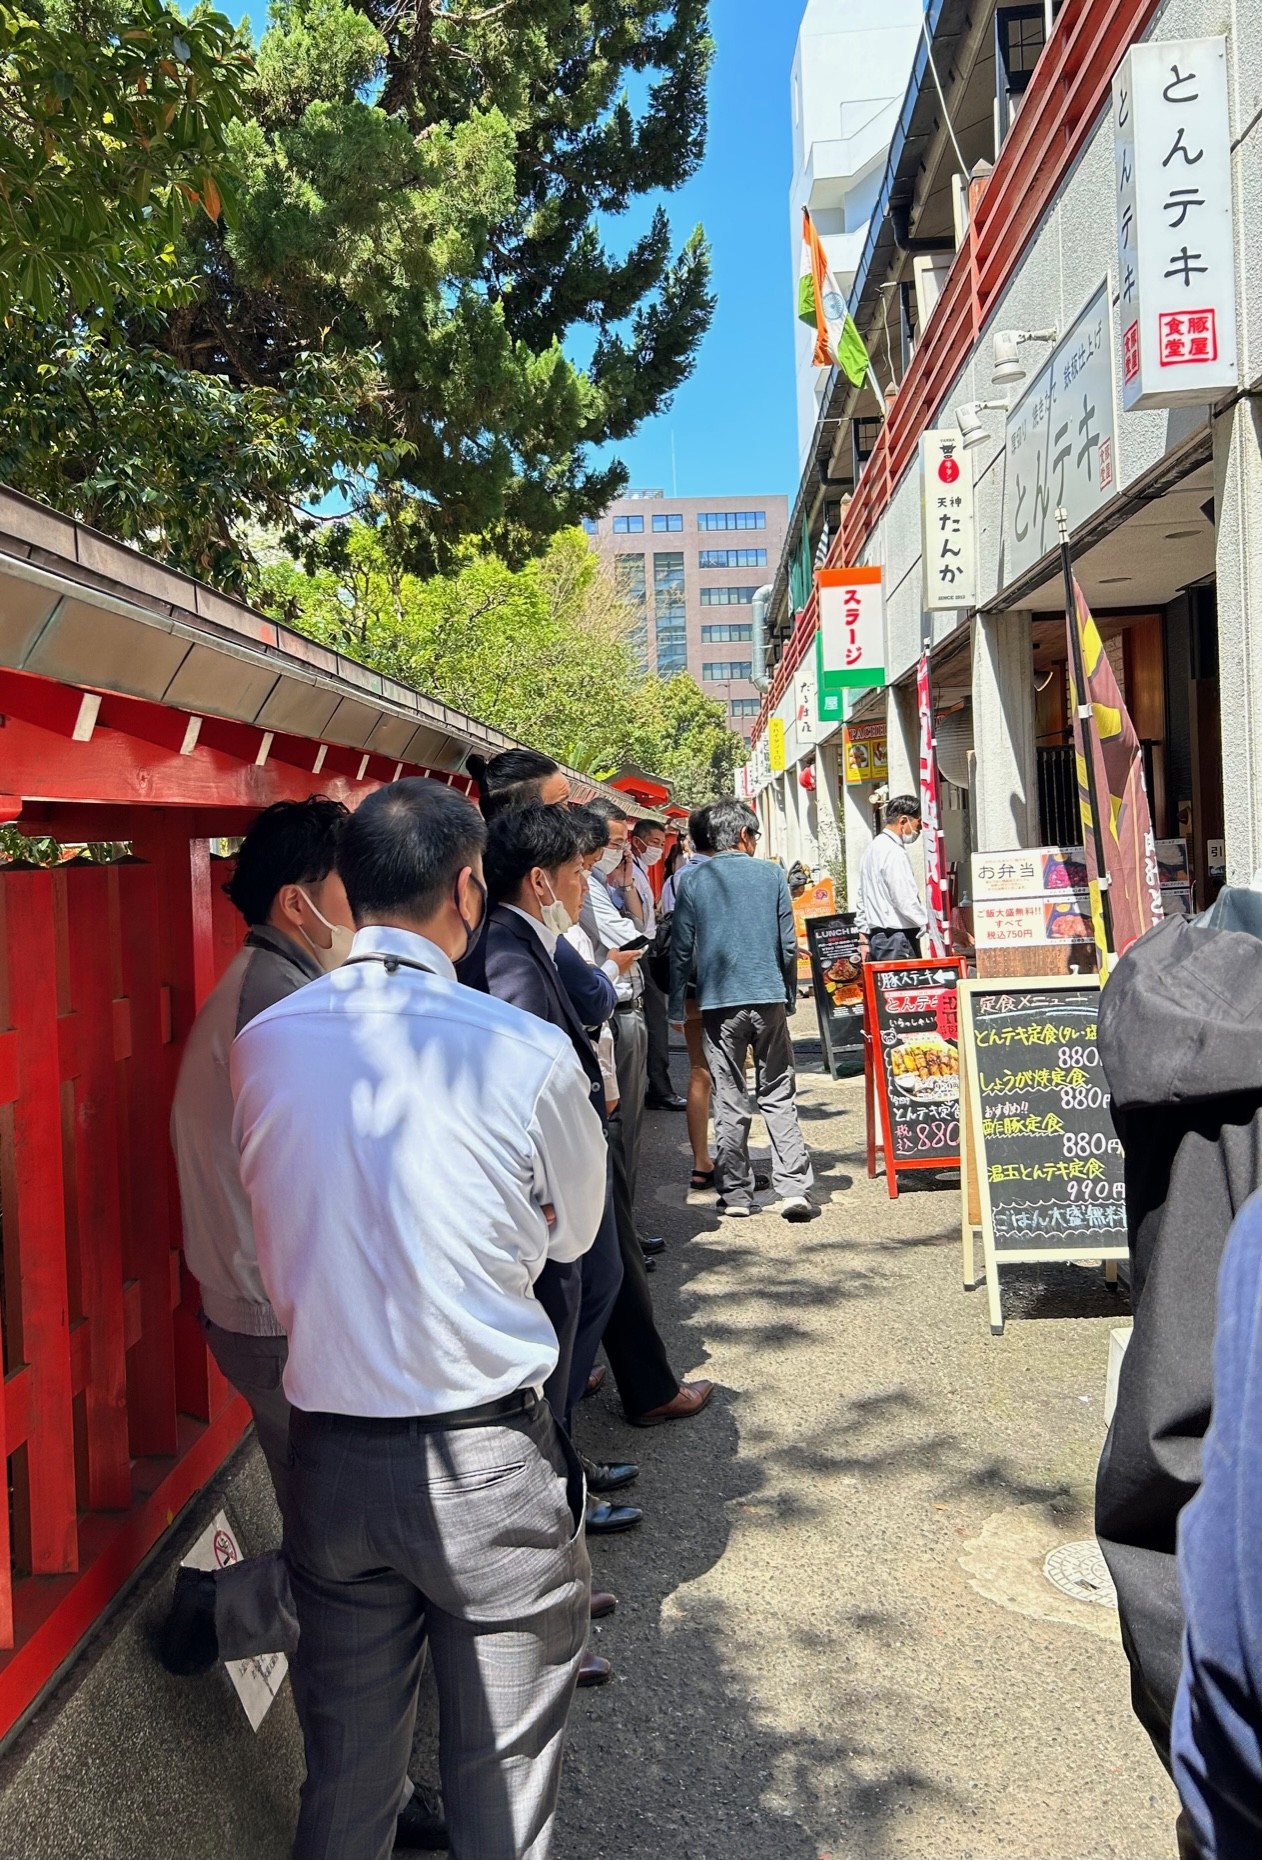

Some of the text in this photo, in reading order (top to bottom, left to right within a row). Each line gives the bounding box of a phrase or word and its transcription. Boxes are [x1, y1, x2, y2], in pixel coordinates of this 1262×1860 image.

[1162, 65, 1208, 287] とんテキ
[1119, 90, 1136, 305] とんテキ
[937, 496, 962, 509] 天神
[938, 513, 964, 584] たんか
[843, 589, 863, 666] スラージ
[978, 862, 1034, 880] お弁当
[815, 928, 850, 939] LUNCH
[987, 929, 1033, 940] 税込750円
[995, 919, 1022, 928] すべて
[979, 994, 1089, 1013] 定食メニュー
[1058, 1046, 1103, 1068] 880
[979, 1067, 1091, 1091] しょうが焼定食
[1062, 1133, 1122, 1157] 880円
[987, 1157, 1107, 1182] 温玉とんテキ定食
[1067, 1180, 1126, 1200] 990円
